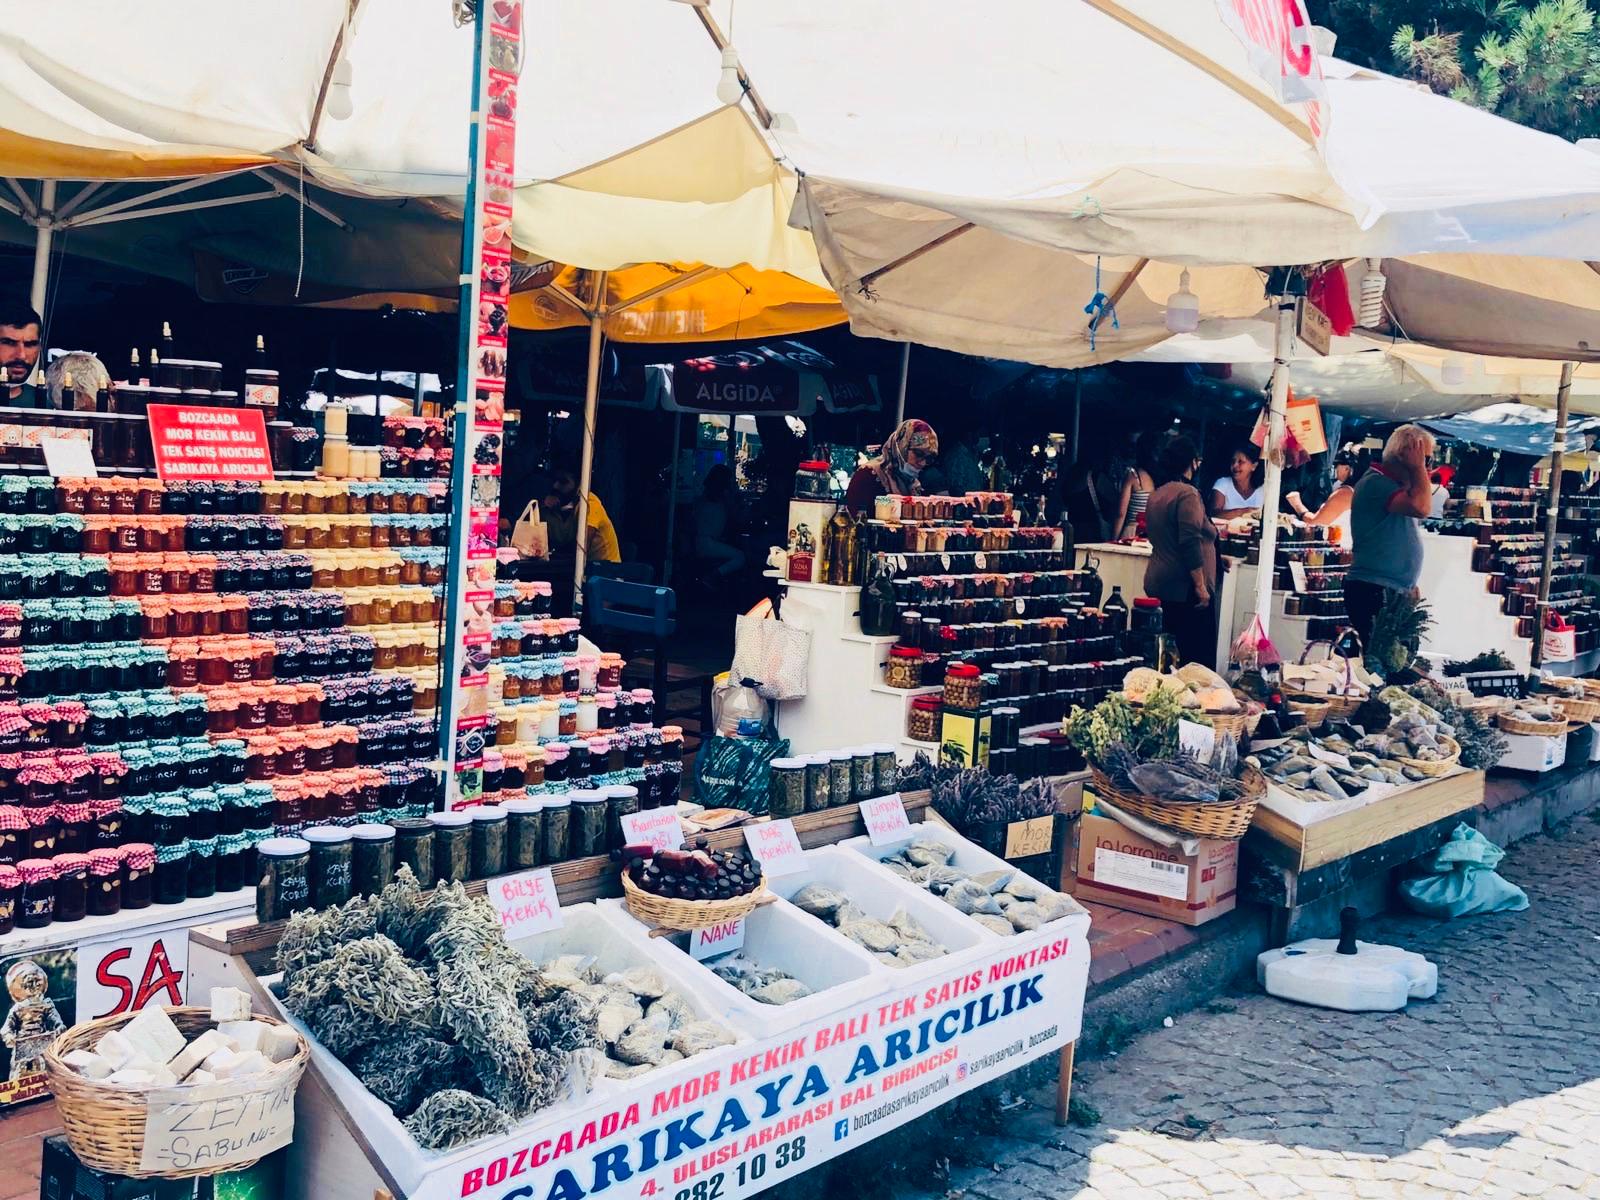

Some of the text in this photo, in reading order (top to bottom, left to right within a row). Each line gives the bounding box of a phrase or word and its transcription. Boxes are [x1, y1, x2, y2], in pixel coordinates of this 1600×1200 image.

[178, 411, 239, 425] BOZCAADA
[165, 427, 257, 442] MOR KEKİK BALI
[161, 445, 265, 460] TEK SATIŞ NOKTASI
[163, 462, 269, 475] SARIKAYA ARICILIK
[700, 920, 741, 946] NANE
[844, 973, 1044, 1084] ARICILIK
[460, 937, 1069, 1198] BOZCAADA MOR KEKİK BALI TEK SATIŞ NOKTASI
[673, 1099, 834, 1185] ULUSLARARASI
[840, 1083, 876, 1111] BAL
[736, 1153, 766, 1187] 10
[775, 1135, 806, 1169] 38
